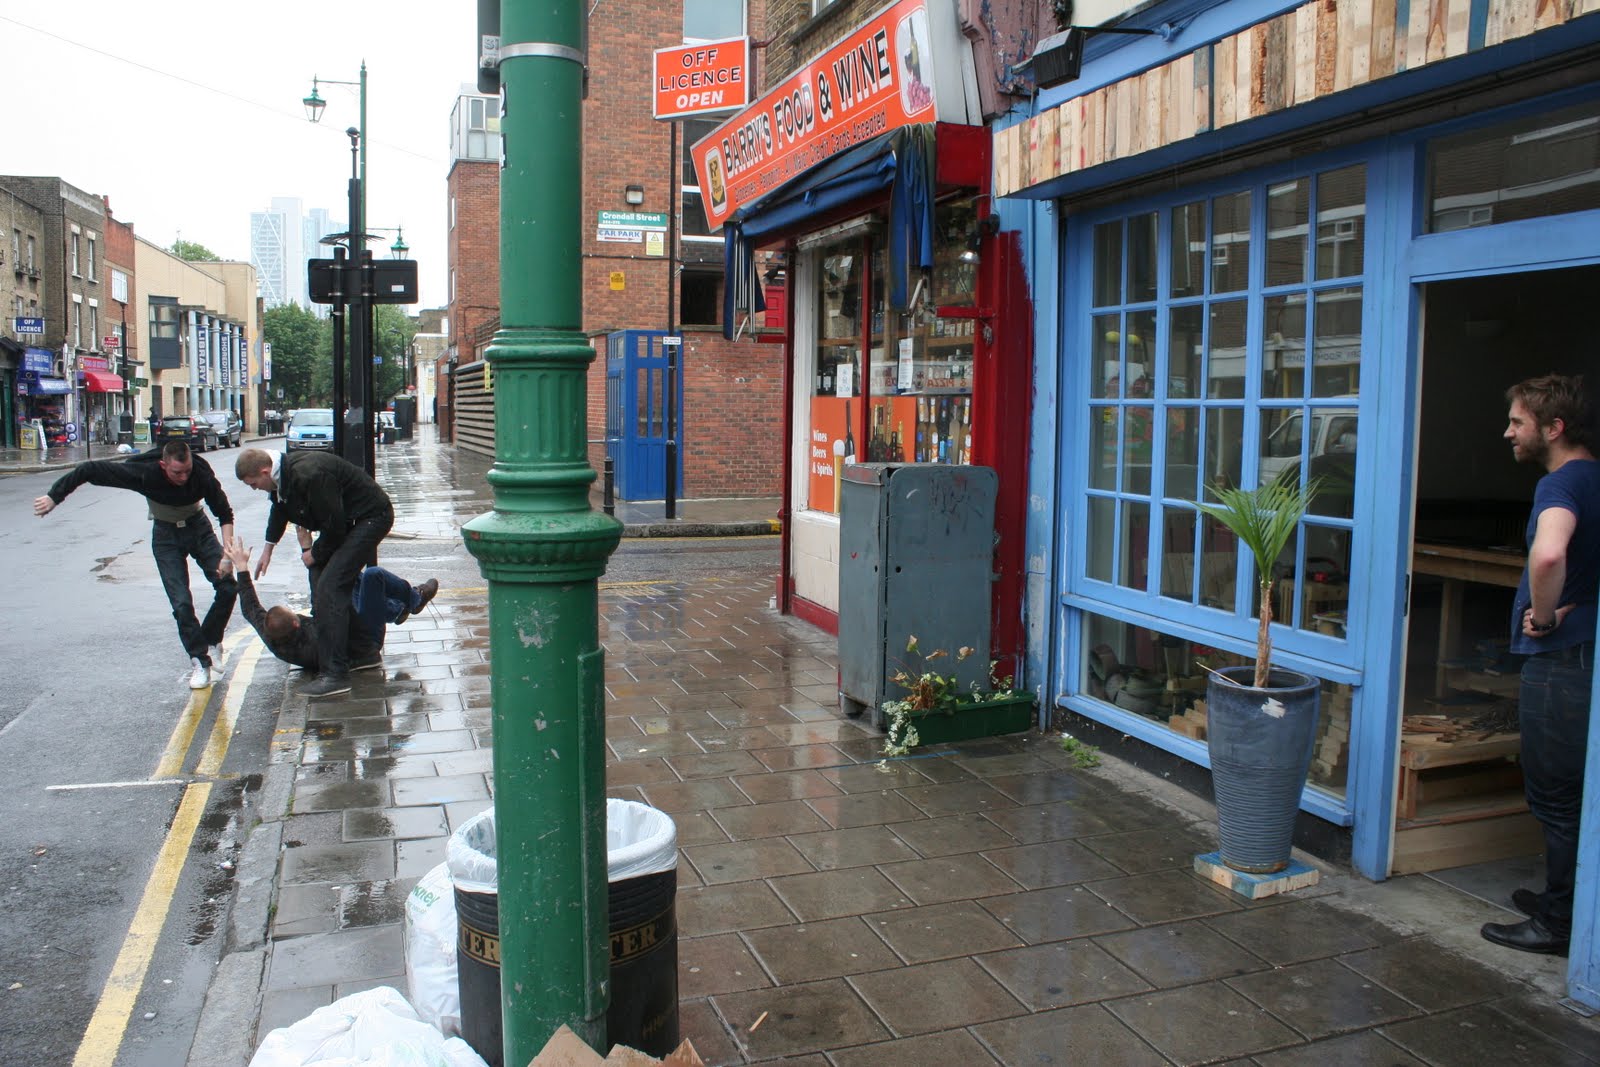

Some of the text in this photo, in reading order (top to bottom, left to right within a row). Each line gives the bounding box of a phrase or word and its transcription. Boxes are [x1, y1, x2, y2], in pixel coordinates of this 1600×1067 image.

[682, 49, 718, 68] OFF
[659, 67, 741, 92] LICENCE
[676, 90, 724, 109] OPEN
[722, 26, 893, 179] BARRY'S FOOD & WINE
[853, 106, 886, 141] Accepted
[602, 212, 635, 220] Crondall
[198, 330, 206, 381] LIBRARY
[813, 429, 828, 442] Wines
[812, 445, 827, 458] Beers
[817, 463, 833, 477] Spirits
[461, 925, 500, 962] TER
[608, 922, 656, 961] TER
